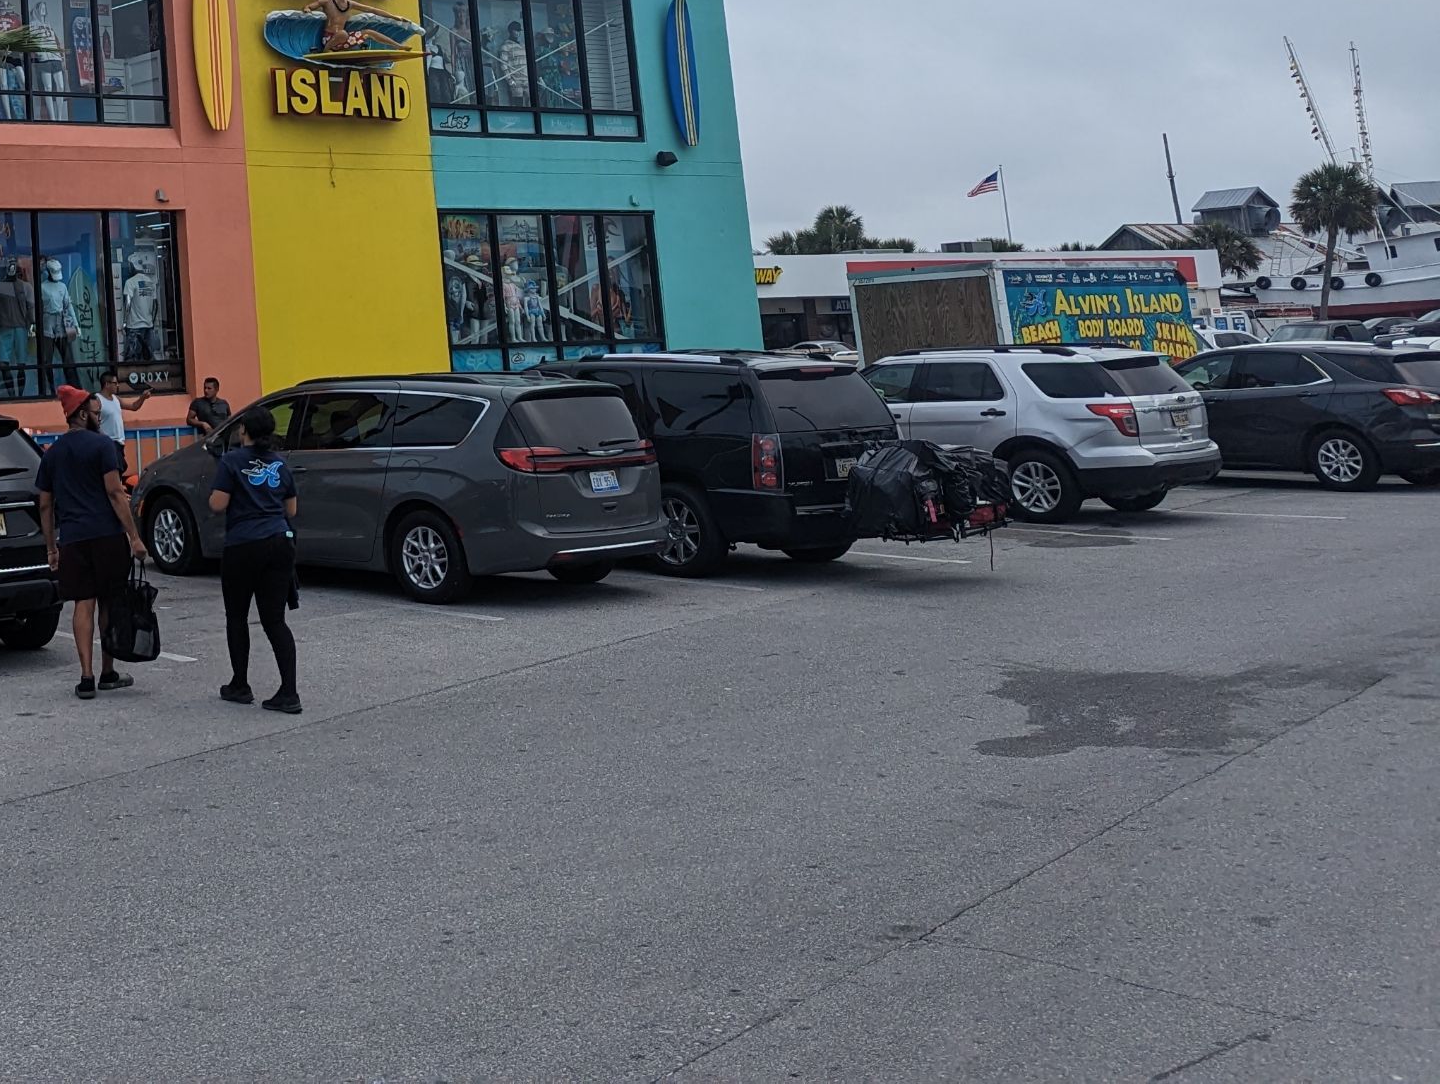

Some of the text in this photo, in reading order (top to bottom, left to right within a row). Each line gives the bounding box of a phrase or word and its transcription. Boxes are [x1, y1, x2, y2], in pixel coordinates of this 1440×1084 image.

[271, 68, 411, 122] ISLAND
[1054, 288, 1120, 315] ALVIN'S
[1125, 288, 1183, 314] ISLAND
[1021, 320, 1060, 344] BEACH
[1077, 318, 1145, 338] BODY BOARDS
[1153, 339, 1198, 359] BOARDS
[140, 371, 170, 383] ROXY
